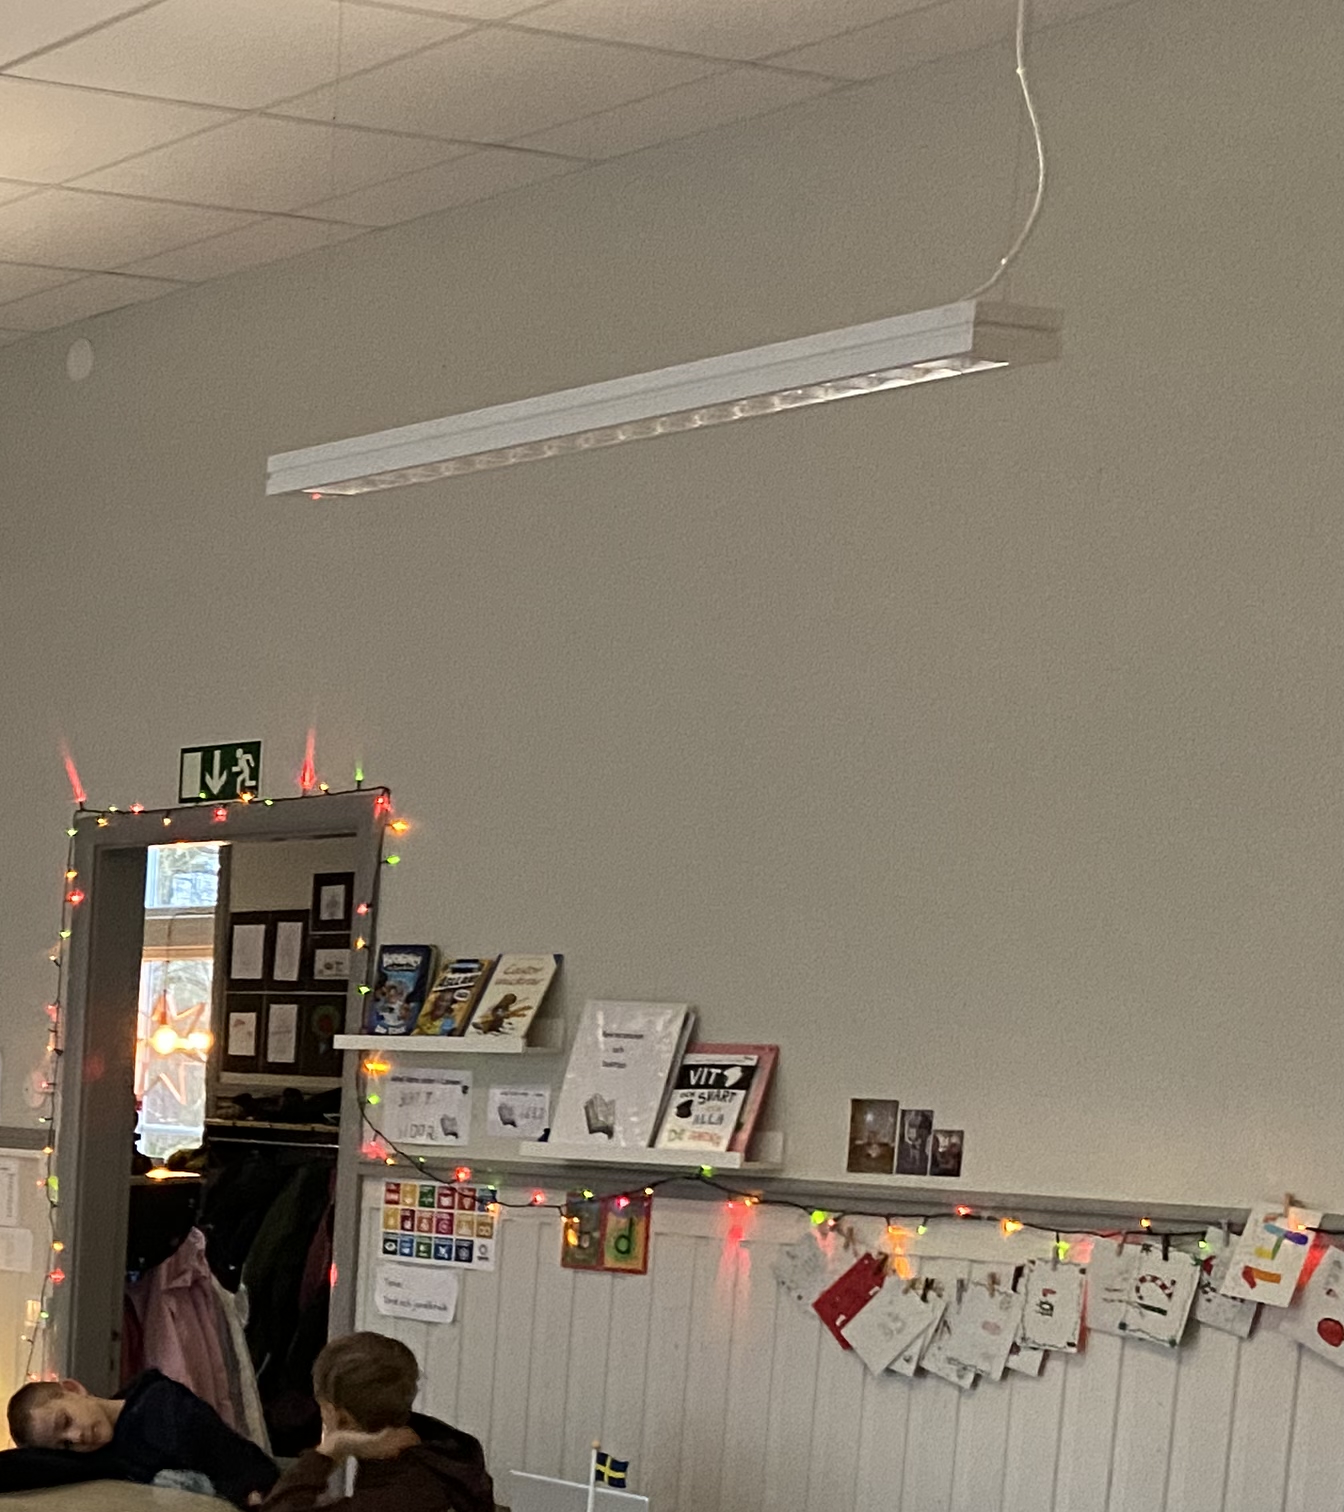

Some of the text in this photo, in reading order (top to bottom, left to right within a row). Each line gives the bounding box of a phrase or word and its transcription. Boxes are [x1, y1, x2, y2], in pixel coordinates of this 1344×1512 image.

[688, 1067, 722, 1087] VIT
[697, 1090, 738, 1105] SVART
[691, 1113, 725, 1127] ALLA
